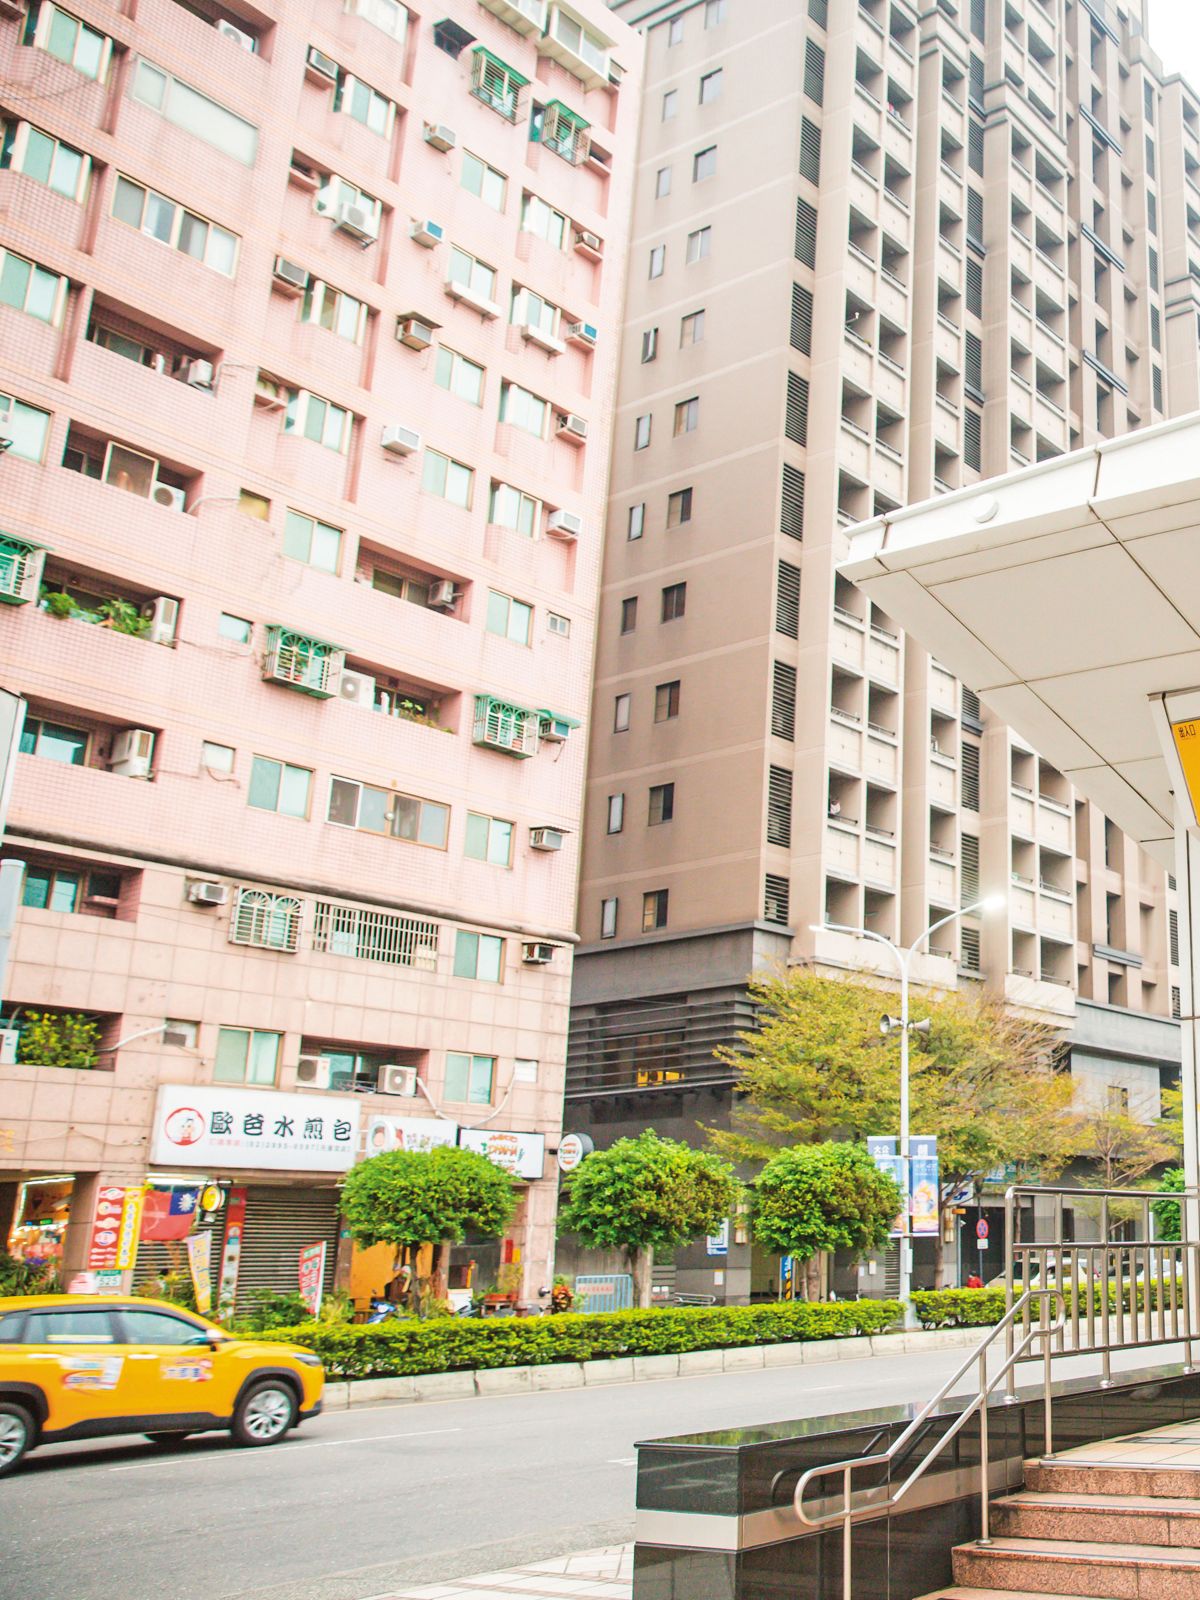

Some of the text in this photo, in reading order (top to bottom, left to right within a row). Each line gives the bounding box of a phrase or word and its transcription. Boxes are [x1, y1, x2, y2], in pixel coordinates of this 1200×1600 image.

[1177, 723, 1197, 738] 出入口
[209, 1110, 352, 1142] 歐爸水煎包
